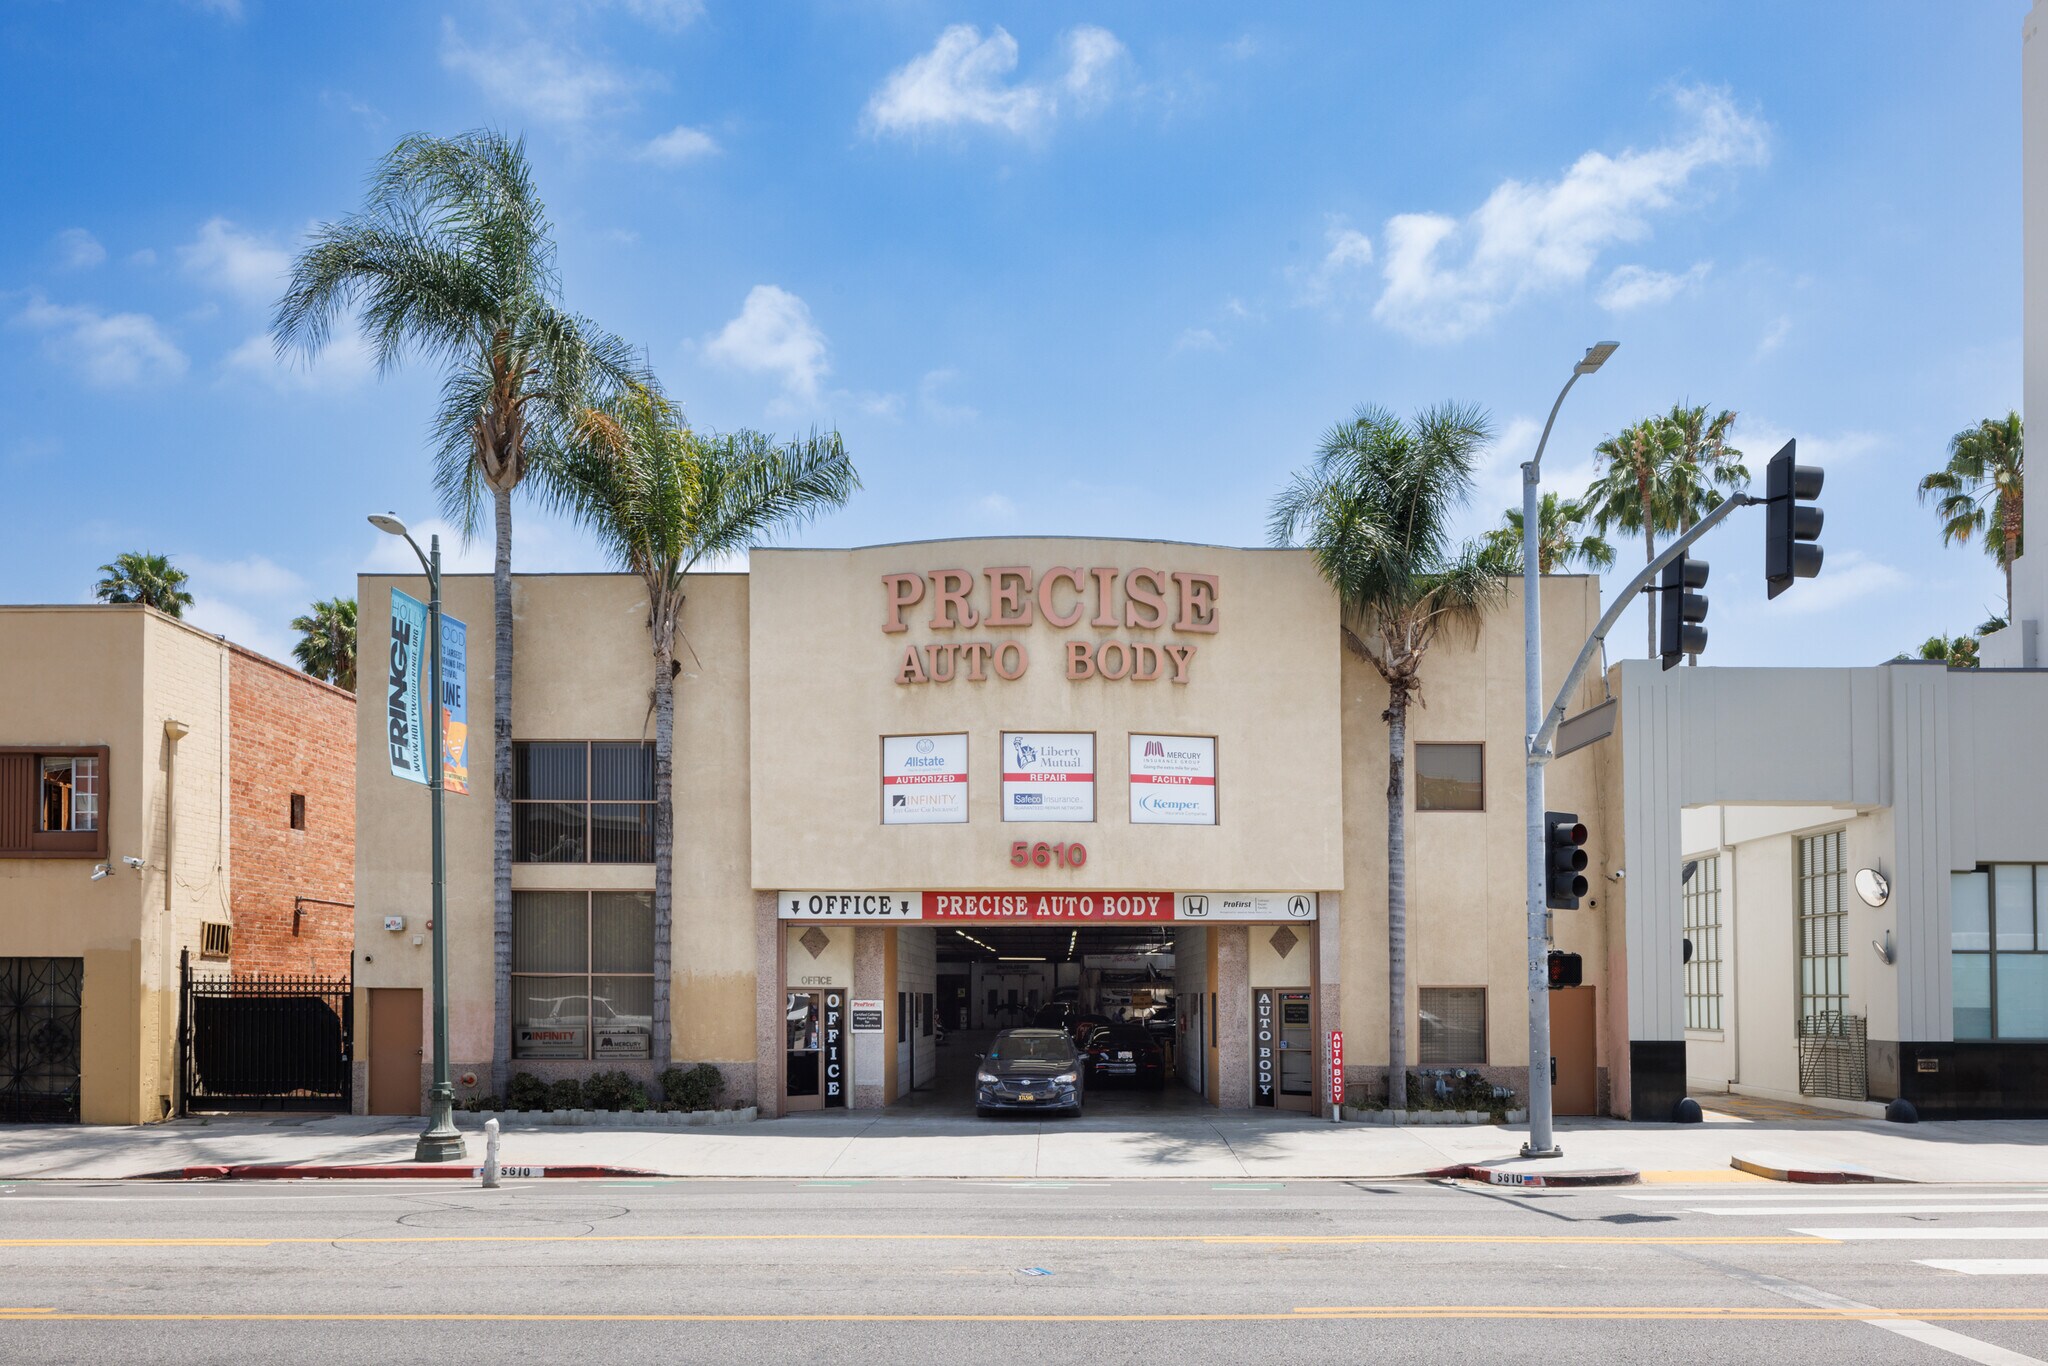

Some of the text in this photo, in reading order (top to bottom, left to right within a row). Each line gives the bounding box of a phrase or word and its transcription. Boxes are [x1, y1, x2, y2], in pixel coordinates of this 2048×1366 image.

[881, 566, 1219, 634] PRECISE
[895, 640, 1198, 684] AUTO BODY
[389, 616, 411, 770] FRINGE
[443, 681, 461, 708] UNE
[1041, 747, 1080, 761] Liberty
[904, 756, 944, 767] Allstate
[1041, 757, 1081, 767] Mutual
[896, 775, 955, 784] AUTHORIZED
[1030, 774, 1067, 782] REPAIR
[1152, 776, 1193, 784] FACILITY
[907, 794, 956, 805] INFINITY
[1015, 794, 1042, 804] Safeco
[1153, 799, 1199, 810] Kemper
[1010, 841, 1087, 869] 5610
[809, 895, 892, 915] OFFICE
[936, 896, 1160, 916] PRECISE AUTO BODY
[801, 976, 832, 985] OFFICE
[1259, 994, 1272, 1041] AUTO
[532, 1032, 575, 1040] INFINITY
[827, 994, 840, 1096] OFFICE
[1333, 1033, 1341, 1066] AUTO
[1259, 1048, 1272, 1095] BODY
[1334, 1068, 1342, 1101] BODY
[501, 1167, 531, 1177] 5610
[1497, 1172, 1523, 1184] 5610
